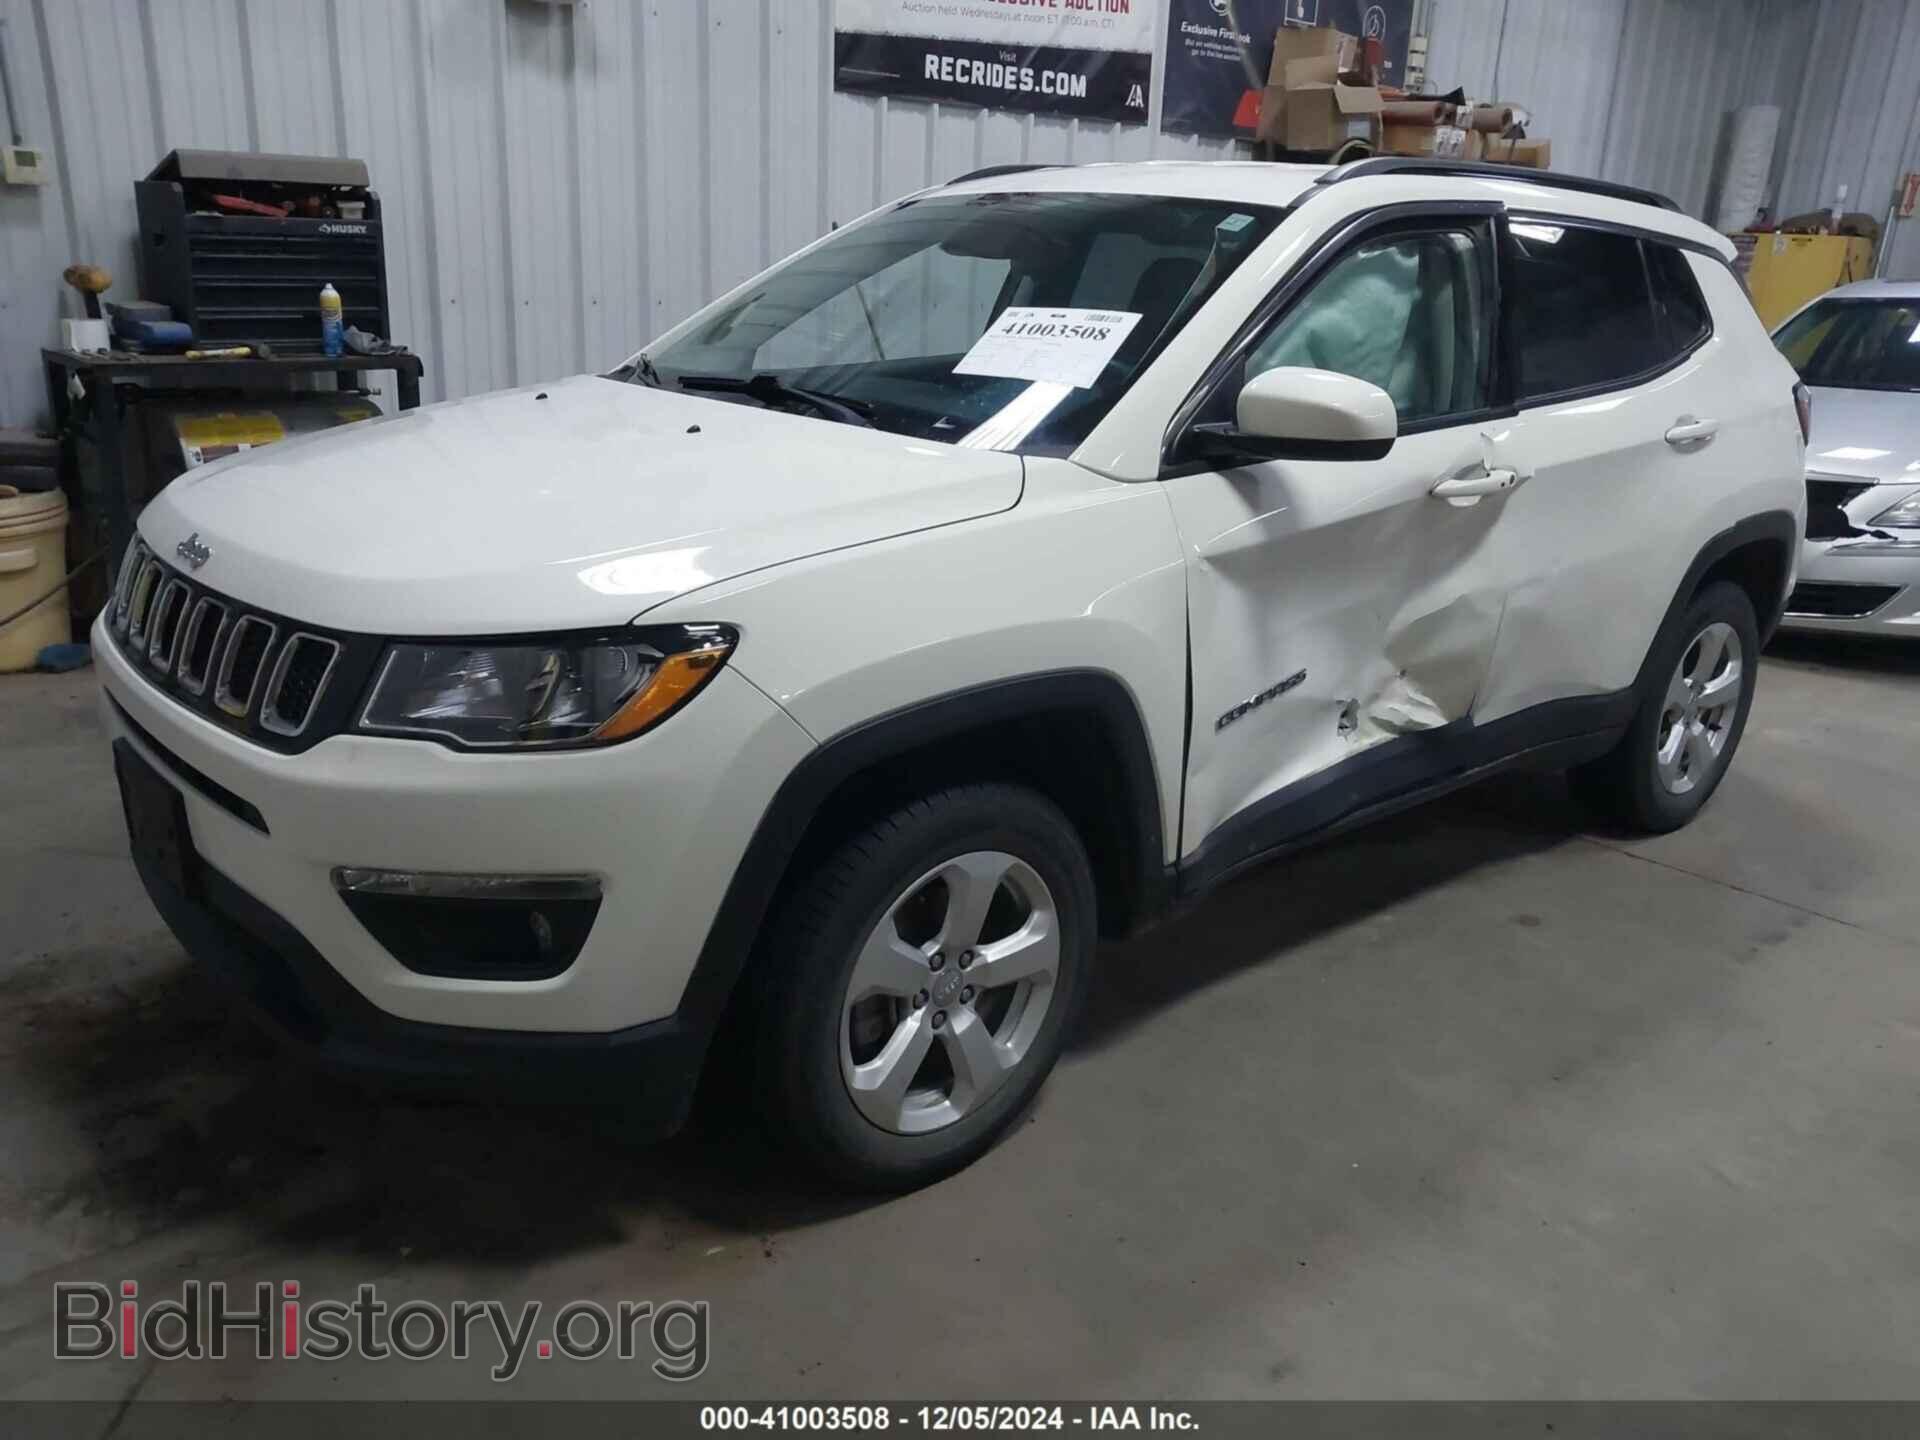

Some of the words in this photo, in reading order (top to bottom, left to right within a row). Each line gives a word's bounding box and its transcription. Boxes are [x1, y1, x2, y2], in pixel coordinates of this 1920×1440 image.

[902, 1, 936, 13] Auction
[1180, 21, 1218, 38] Exclusive
[1000, 50, 1017, 62] Visit
[925, 53, 1087, 98] RECRIDES.COM
[331, 224, 368, 235] HUSKY
[1002, 321, 1111, 341] 41003508
